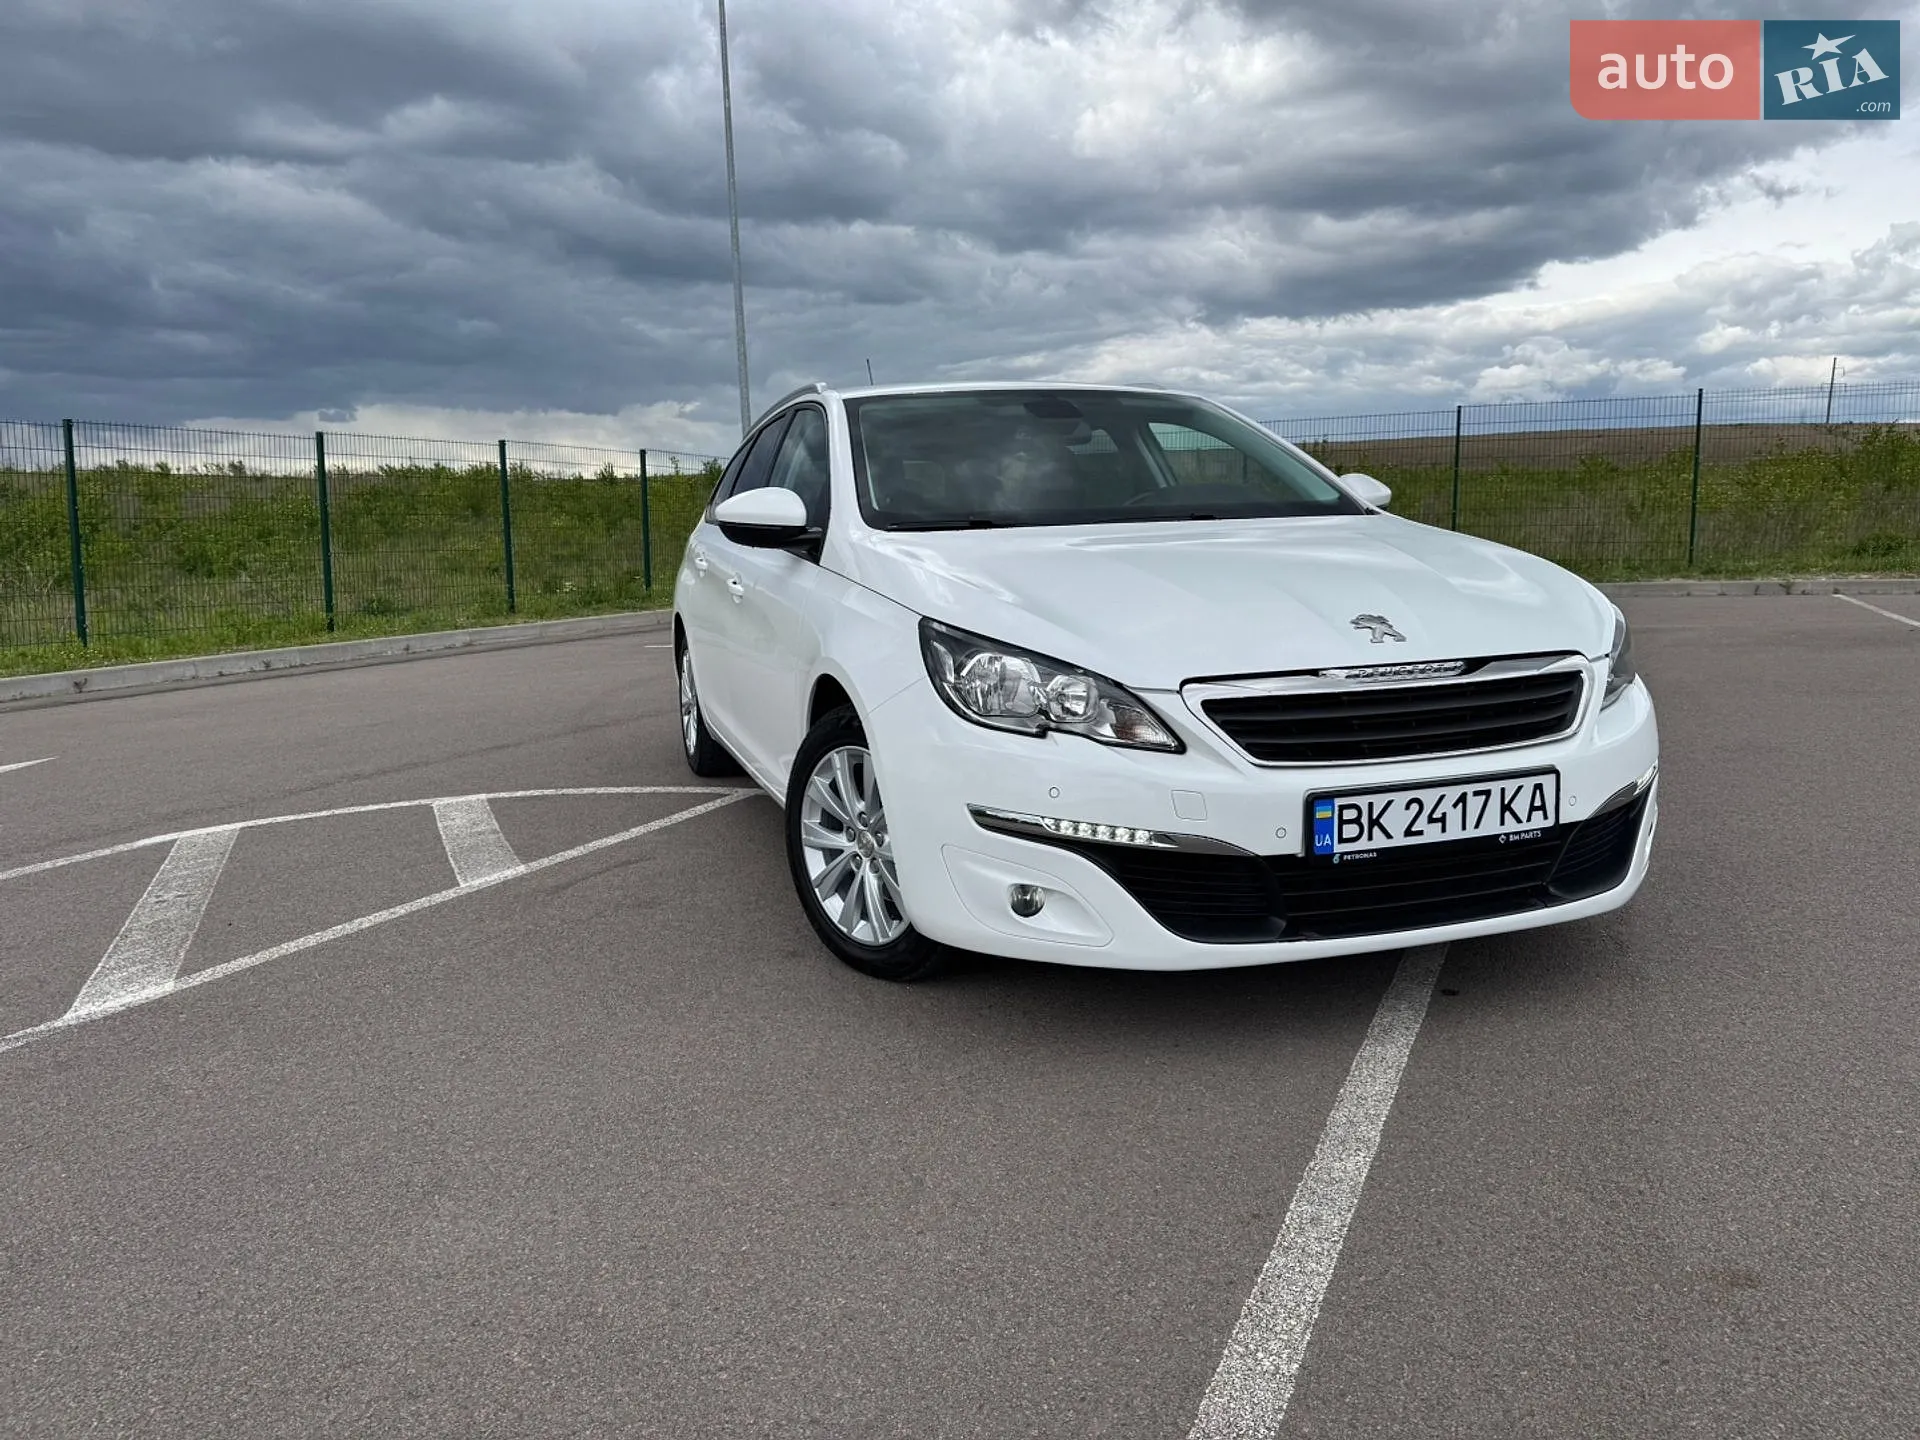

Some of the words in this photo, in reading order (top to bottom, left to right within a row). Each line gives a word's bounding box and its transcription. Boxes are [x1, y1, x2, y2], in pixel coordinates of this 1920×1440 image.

[1337, 799, 1394, 844] BK
[1403, 788, 1492, 838] 2417
[1499, 782, 1549, 827] KA
[1315, 833, 1332, 847] UA
[1520, 830, 1542, 840] PARTS
